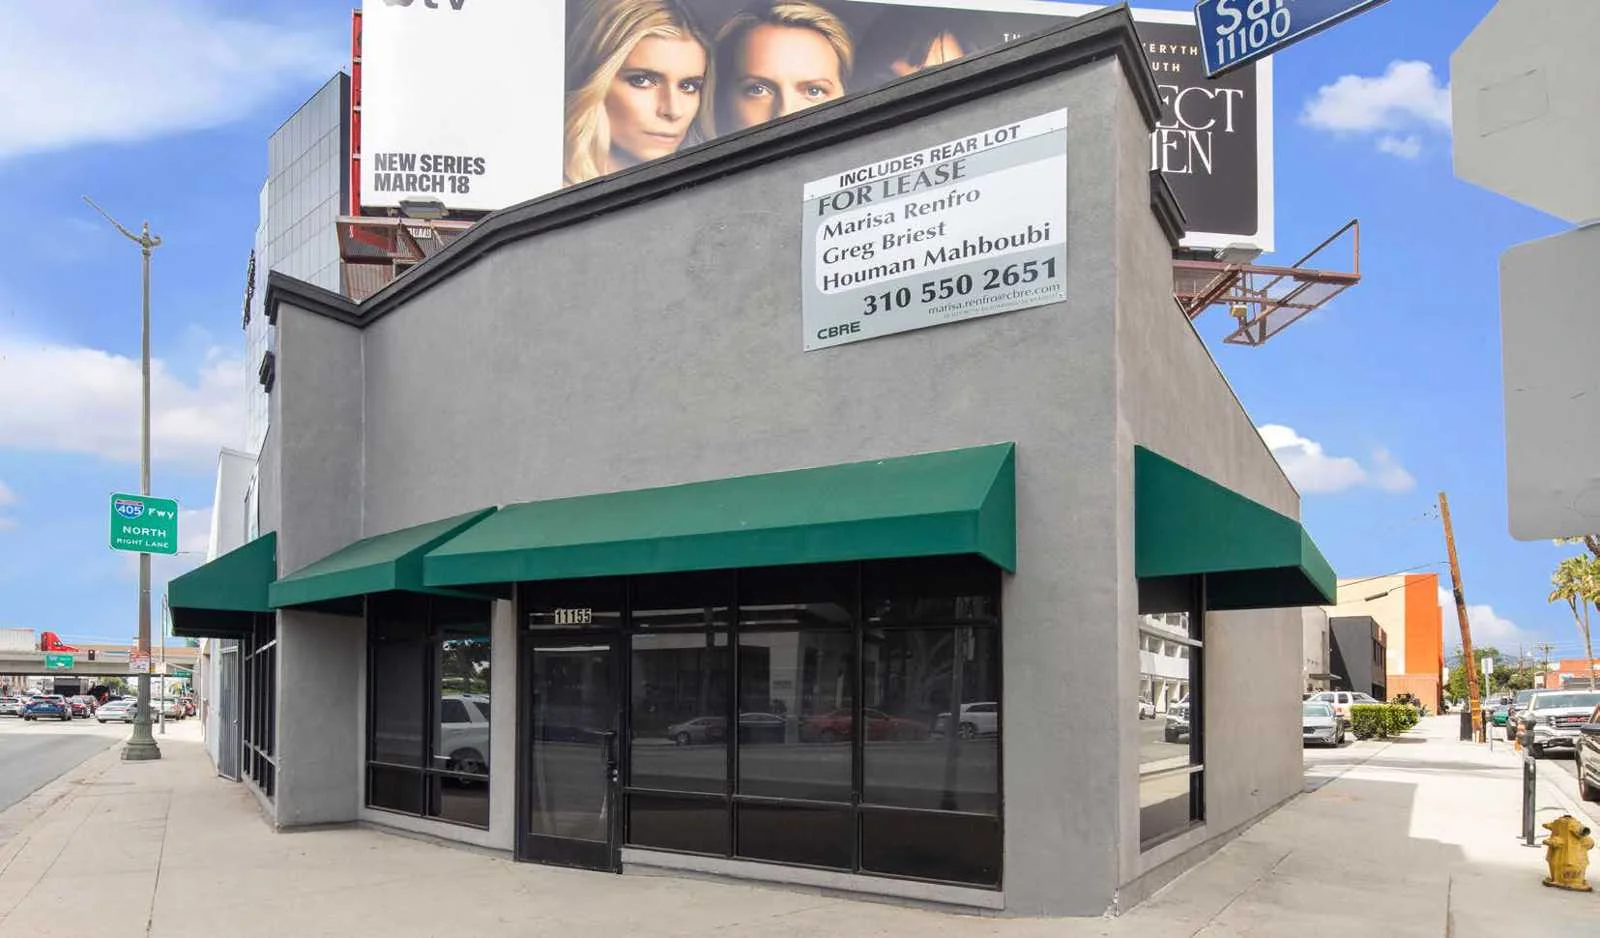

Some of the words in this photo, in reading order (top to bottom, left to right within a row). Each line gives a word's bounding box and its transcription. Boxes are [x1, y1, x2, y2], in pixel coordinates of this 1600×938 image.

[1144, 43, 1199, 56] ERYTH
[1216, 8, 1291, 65] 11100
[374, 153, 416, 172] NEW
[420, 154, 486, 175] SERIES
[840, 153, 924, 187] INCLUDES
[930, 138, 978, 163] REAR
[984, 125, 1021, 146] LOT
[374, 173, 444, 193] MARCH
[449, 175, 470, 194] 18
[818, 184, 873, 216] FOR
[883, 159, 967, 199] LEASE
[823, 210, 895, 240] Marisa
[904, 188, 981, 220] Renfro
[822, 241, 875, 265] Greg
[882, 221, 946, 250] Briest
[823, 257, 915, 291] Houman
[924, 222, 1051, 267] Mahboubi
[863, 287, 911, 316] 310
[921, 274, 973, 303] 550
[983, 257, 1056, 291] 2651
[817, 321, 861, 340] CBRE
[118, 505, 141, 515] 405
[148, 508, 174, 519] Fwy
[122, 526, 167, 537] NORTH
[555, 608, 592, 624] 11155
